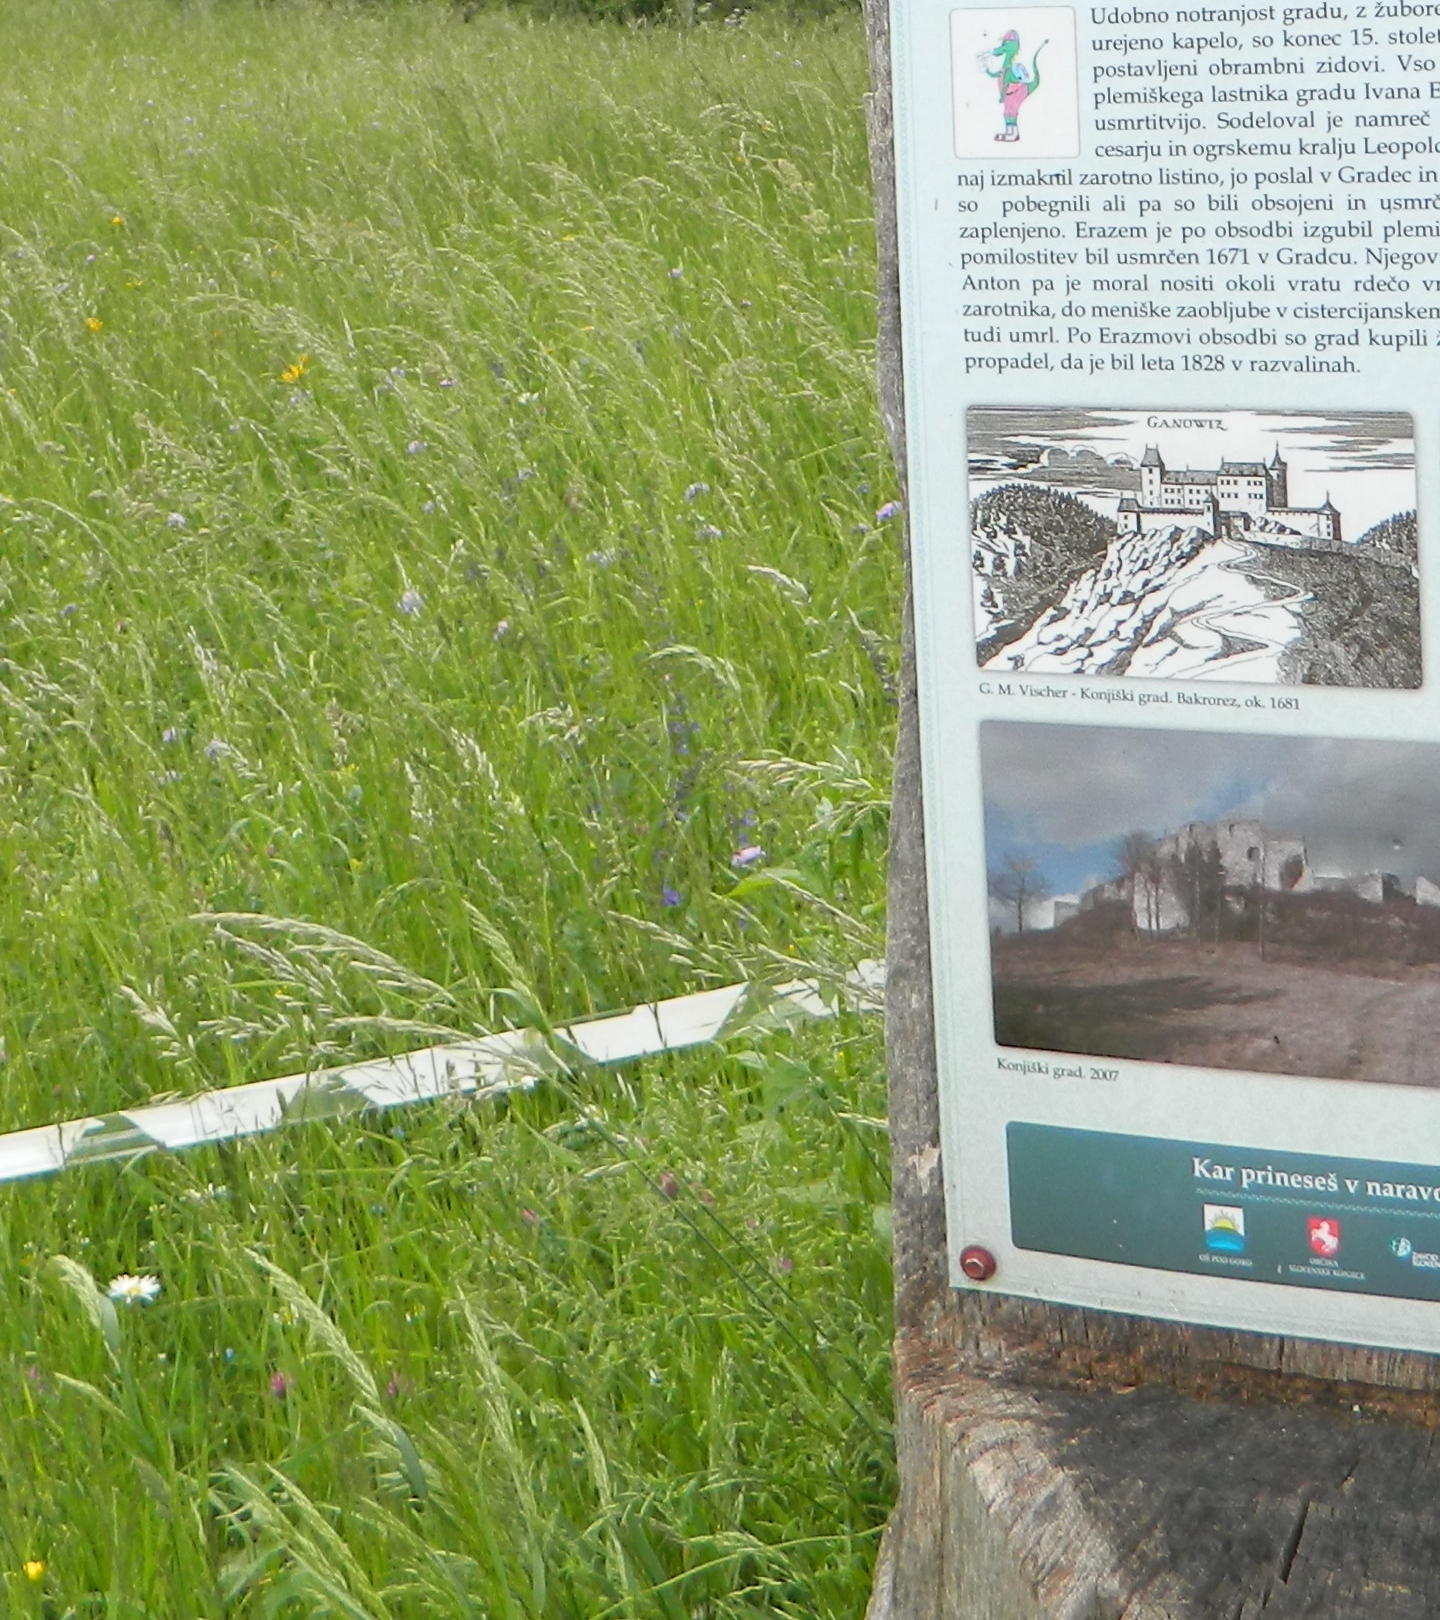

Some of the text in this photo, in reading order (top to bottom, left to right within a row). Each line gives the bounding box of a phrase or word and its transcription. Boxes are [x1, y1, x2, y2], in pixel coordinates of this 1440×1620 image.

[1090, 6, 1170, 25] Udobno
[1175, 4, 1276, 27] notranjost
[1091, 33, 1164, 56] urejeno
[1172, 30, 1244, 55] kapelo,
[1092, 59, 1198, 84] postavljeni
[1208, 56, 1305, 76] obrambni
[1316, 55, 1385, 74] zidovi.
[1093, 85, 1204, 111] plemiškega
[1211, 83, 1289, 103] lastnika
[1363, 82, 1421, 100] Ivana
[1094, 112, 1207, 136] usmrtitvijo.
[1216, 110, 1316, 130] Sodeloval
[1355, 110, 1431, 128] namreč
[1094, 140, 1162, 163] cesarju
[1192, 138, 1292, 163] ogrskemu
[1298, 137, 1357, 161] kralju
[1079, 170, 1153, 186] zarotno
[1158, 167, 1225, 187] listino,
[1254, 165, 1313, 190] poslal
[1337, 165, 1412, 184] Gradec
[1001, 194, 1091, 218] pobegnili
[1251, 193, 1334, 217] obsojeni
[959, 221, 1066, 245] zaplenjeno.
[1075, 221, 1148, 239] Erazem
[1214, 220, 1294, 239] obsodbi
[1303, 219, 1373, 244] izgubil
[960, 247, 1078, 270] pomilostitev
[1116, 249, 1200, 265] usmrčen
[1276, 247, 1358, 266] Gradcu.
[962, 274, 1021, 291] Anton
[1092, 273, 1149, 292] moral
[1160, 274, 1215, 292] nositi
[1225, 273, 1276, 292] okoli
[1287, 276, 1341, 293] vratu
[1353, 273, 1410, 293] rdečo
[962, 299, 1056, 320] zarotnika,
[1091, 300, 1172, 319] meniške
[1176, 300, 1271, 324] zaobljube
[1098, 326, 1192, 345] Erazmovi
[1198, 327, 1277, 346] obsodbi
[1368, 328, 1428, 353] kupili
[964, 351, 1361, 375] propadel, razvalinah.
[978, 682, 994, 695] G.
[998, 683, 1015, 696] M.
[1018, 684, 1068, 699] Vischer
[1080, 687, 1135, 704] Konjiški
[1138, 691, 1173, 706] grad.
[1177, 691, 1241, 709] Bakrorez,
[1244, 695, 1265, 709] ok.
[1270, 697, 1300, 710] 1681
[997, 1057, 1120, 1082] Konjiški grad. 2007
[1192, 1157, 1236, 1181] Kar
[1240, 1164, 1339, 1192] prineseš
[1344, 1179, 1360, 1194] v
